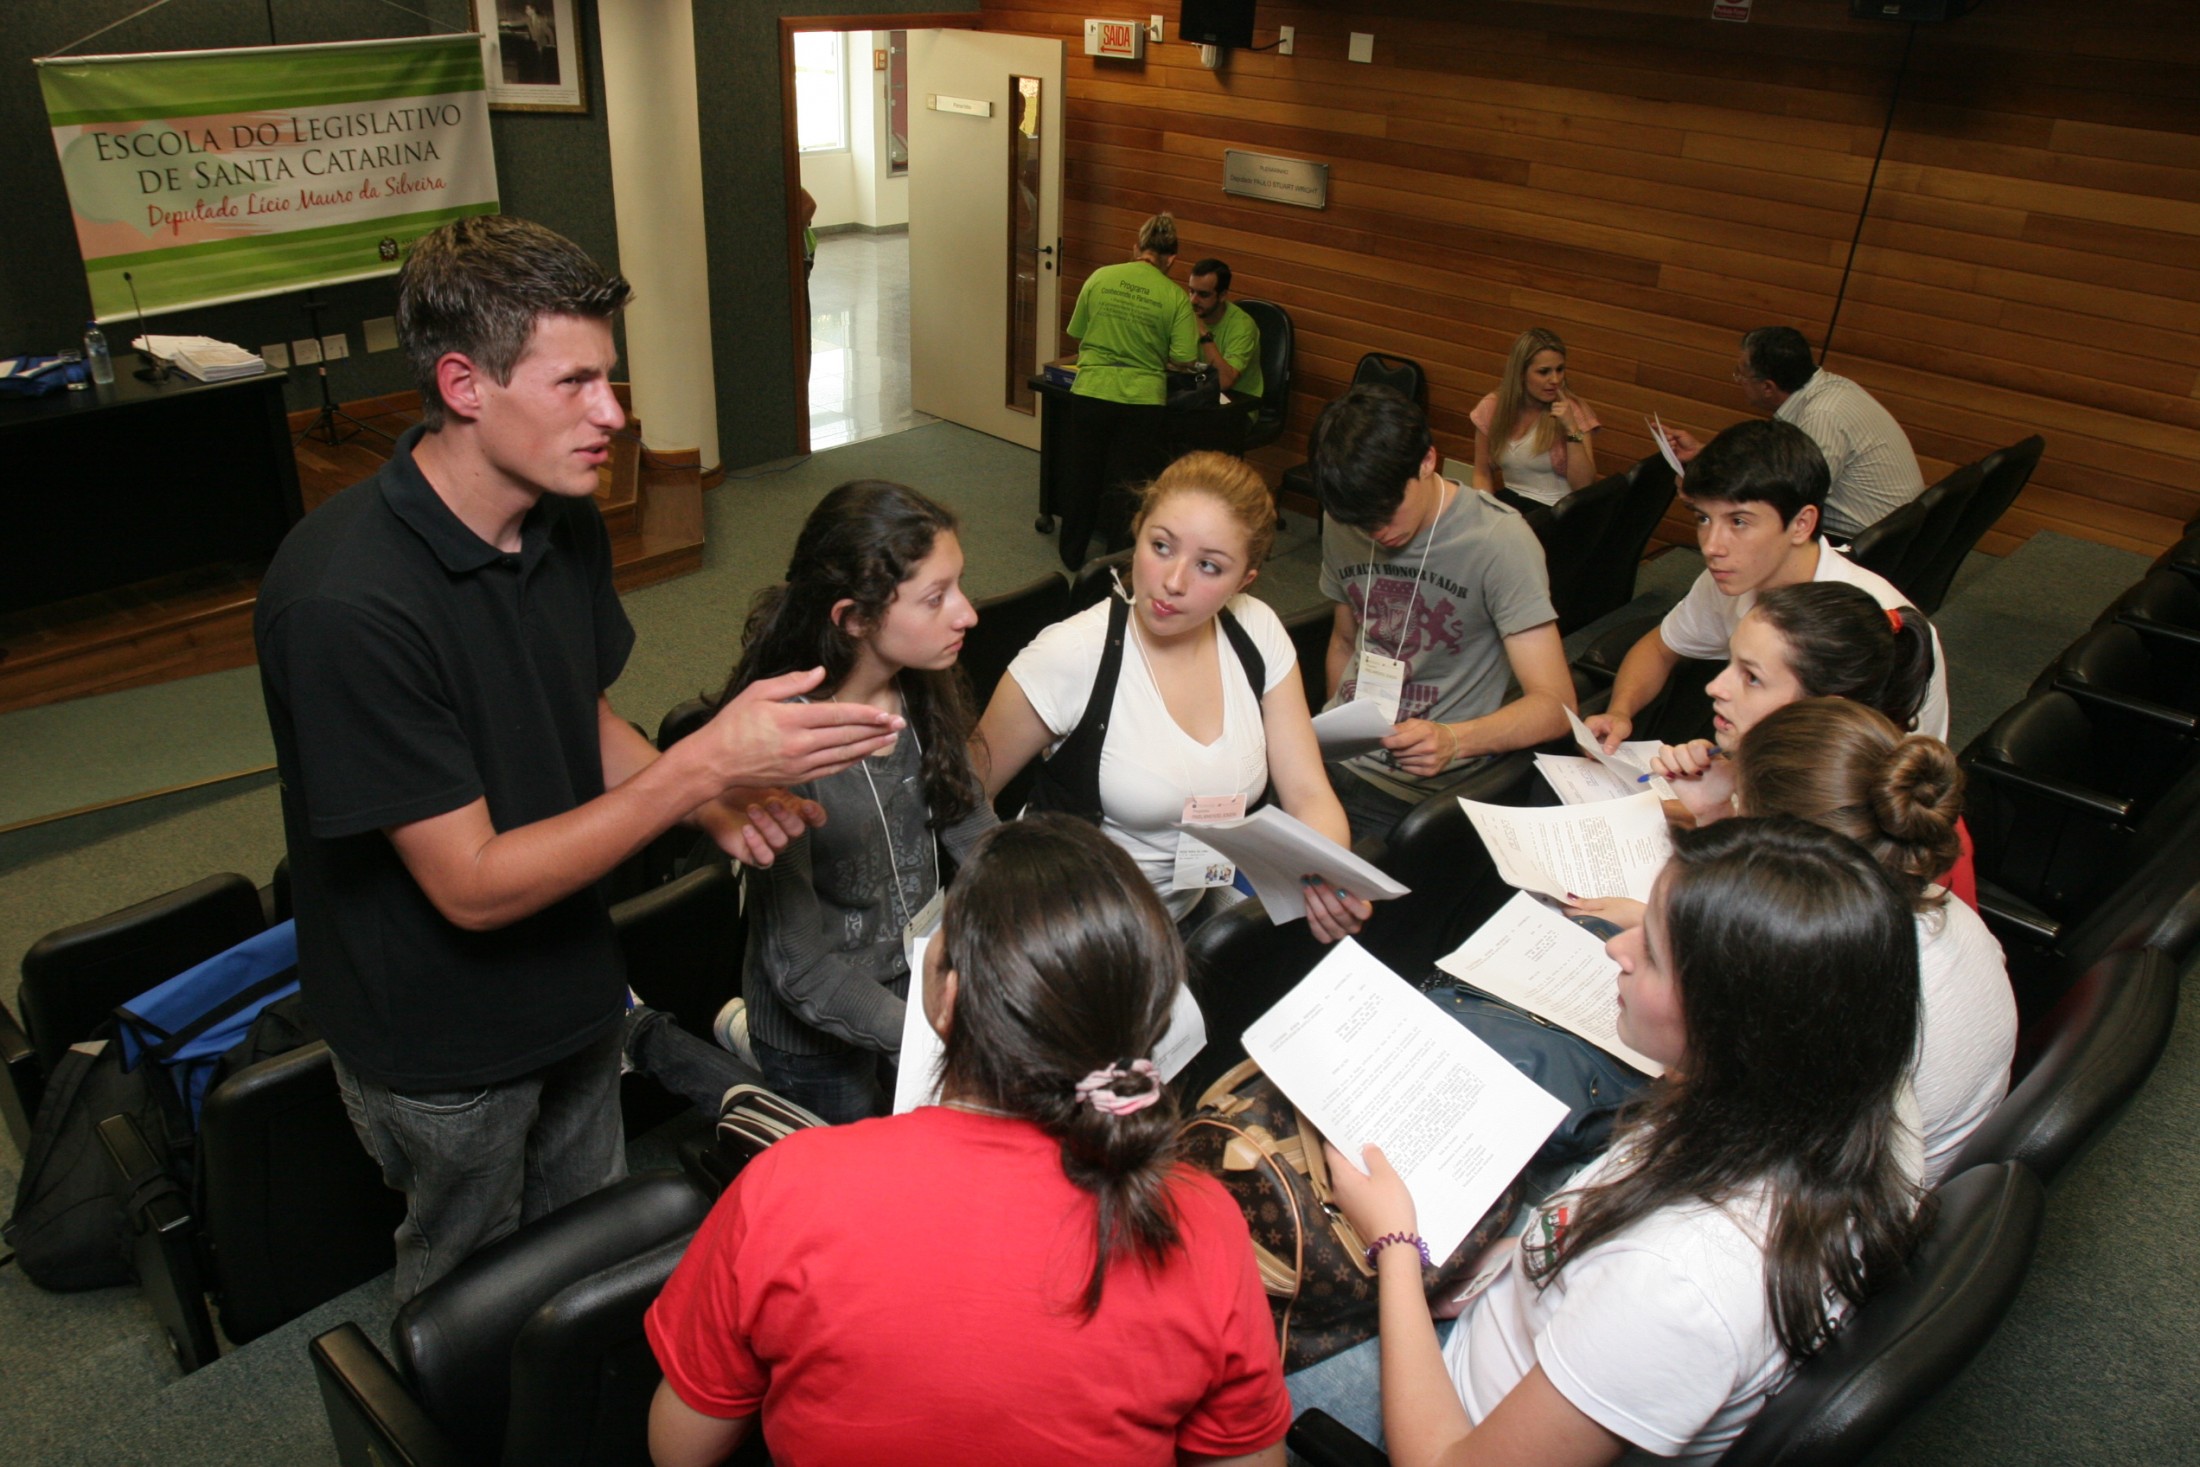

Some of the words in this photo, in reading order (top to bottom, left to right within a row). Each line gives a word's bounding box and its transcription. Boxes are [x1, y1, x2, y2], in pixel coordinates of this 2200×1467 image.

[93, 129, 221, 161] ESCOLA
[231, 122, 280, 149] DO
[291, 104, 461, 143] LEGISLATIVO
[137, 168, 181, 195] DE
[194, 157, 295, 190] SANTA
[302, 140, 441, 176] CATARINA
[1253, 178, 1272, 188] PAULO
[1272, 181, 1294, 191] STUART
[1295, 184, 1318, 195] WRIGHT
[147, 196, 239, 237] Deputado
[295, 188, 353, 210] Mauro
[359, 178, 380, 200] da
[385, 172, 447, 197] Silveira
[1120, 280, 1150, 296] Programa
[1338, 563, 1381, 580] LOYALTY
[1383, 564, 1427, 581] HONOR
[1429, 571, 1469, 599] VALOR
